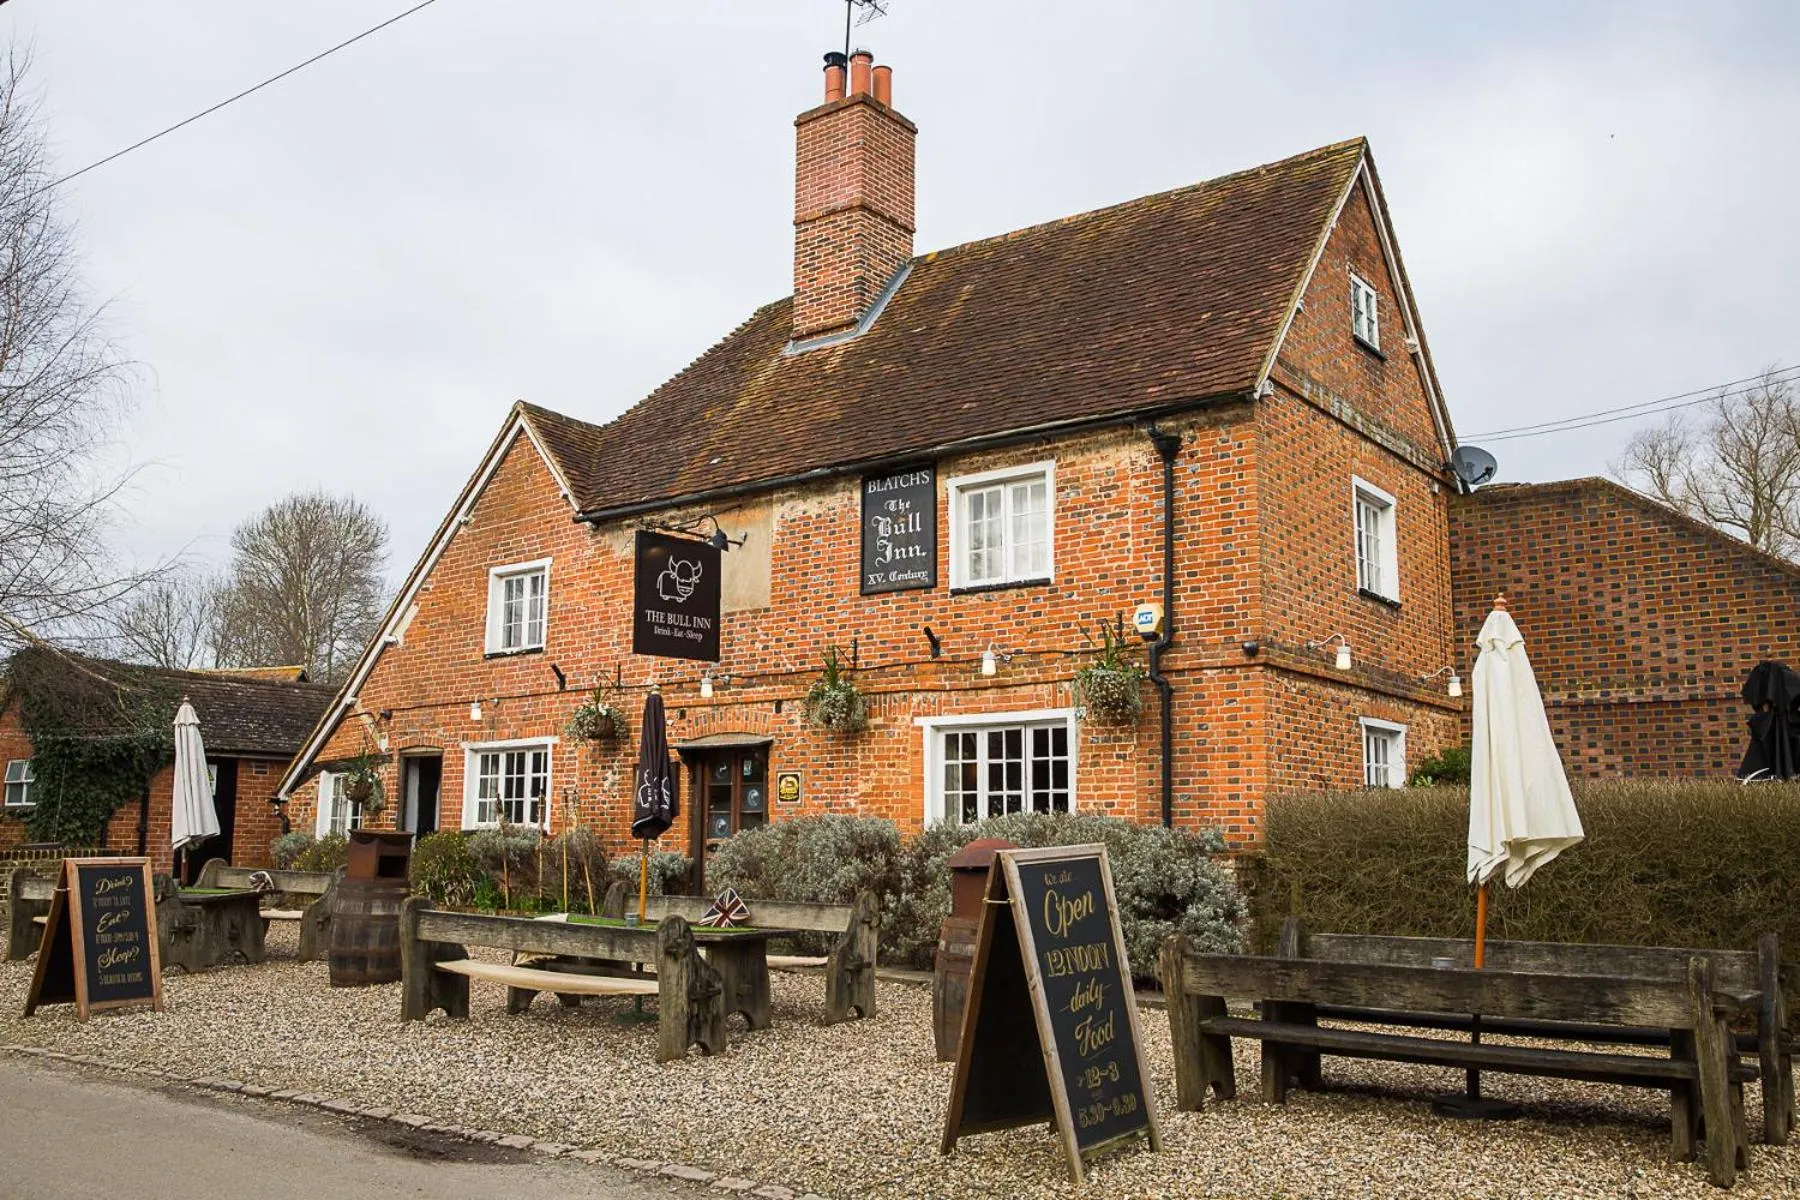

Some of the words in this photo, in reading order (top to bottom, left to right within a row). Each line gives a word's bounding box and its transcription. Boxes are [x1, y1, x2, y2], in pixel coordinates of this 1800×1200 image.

[884, 499, 911, 513] The
[871, 512, 922, 537] Bull
[888, 570, 928, 583] Century
[645, 609, 665, 624] THE
[667, 612, 692, 627] BULL
[693, 616, 712, 629] INN
[1044, 889, 1096, 938] Open
[1070, 977, 1104, 1013] daily
[1075, 1009, 1115, 1057] Food
